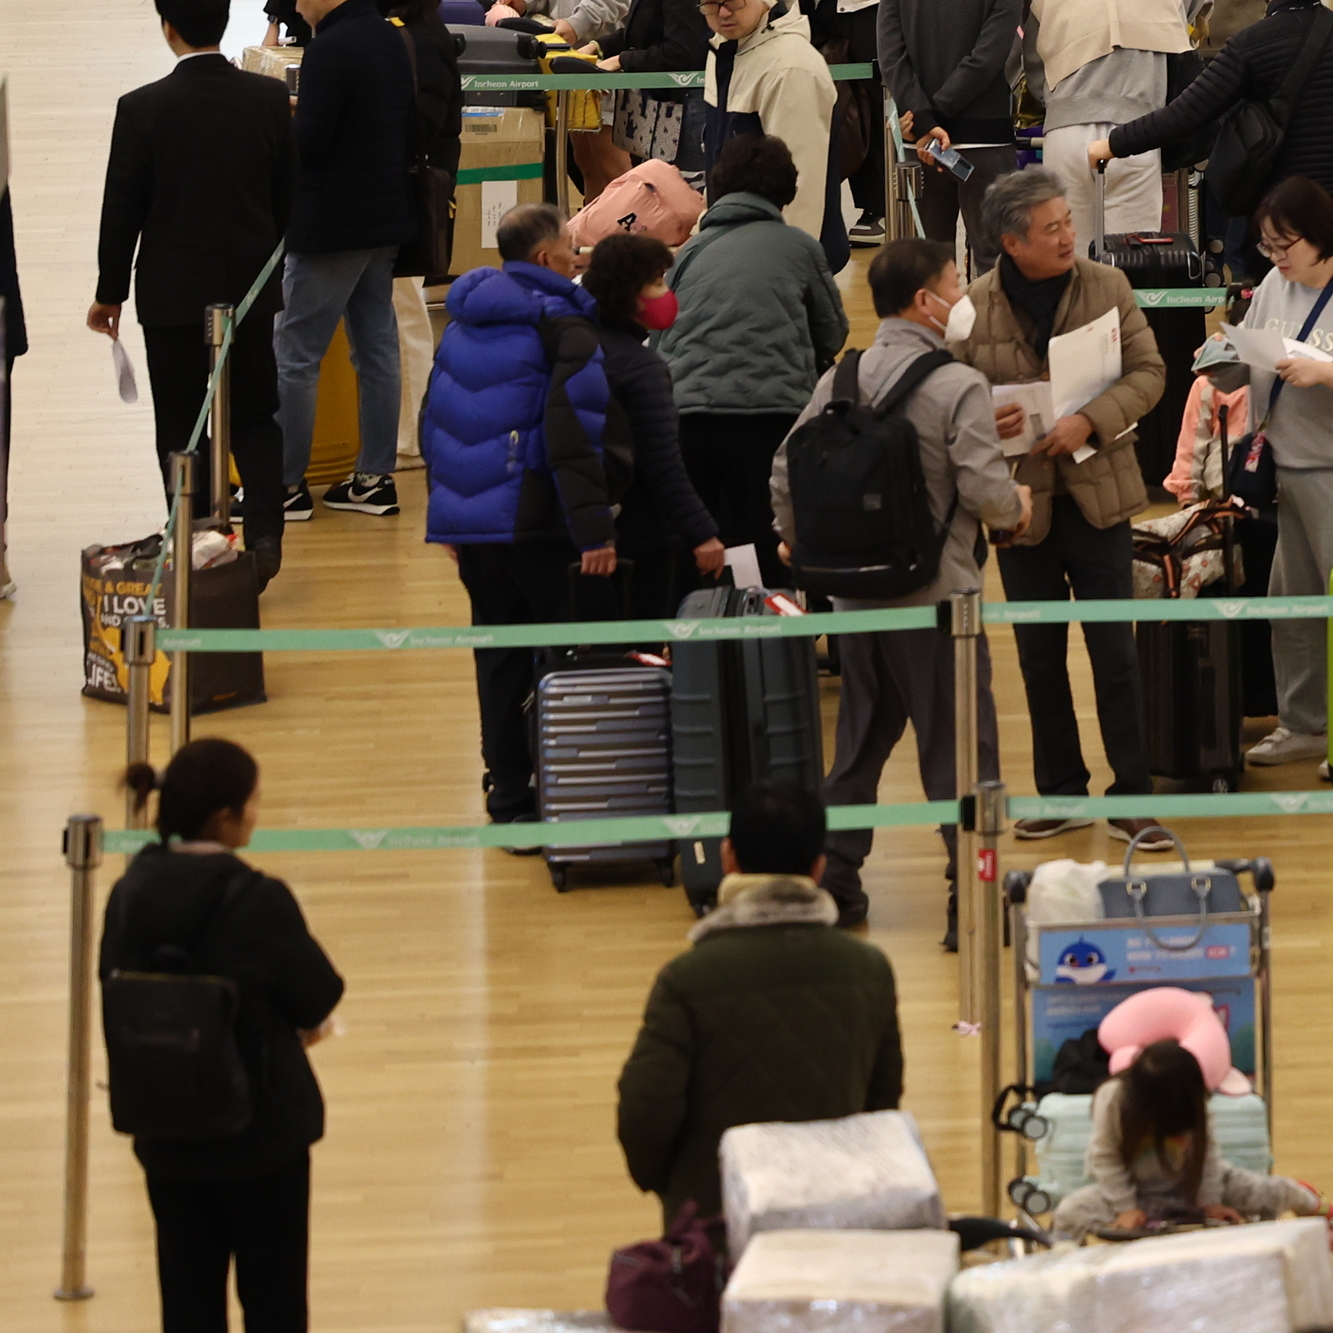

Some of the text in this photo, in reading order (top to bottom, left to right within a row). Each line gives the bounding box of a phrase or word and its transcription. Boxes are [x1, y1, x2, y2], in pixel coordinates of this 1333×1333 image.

[475, 78, 538, 91] Incheon Airport
[1166, 292, 1202, 306] Incheon
[103, 596, 167, 616] I LOVE
[1246, 603, 1331, 616] Incheon Airport
[699, 623, 783, 636] Incheon Airport
[409, 633, 494, 646] Incheon Airport
